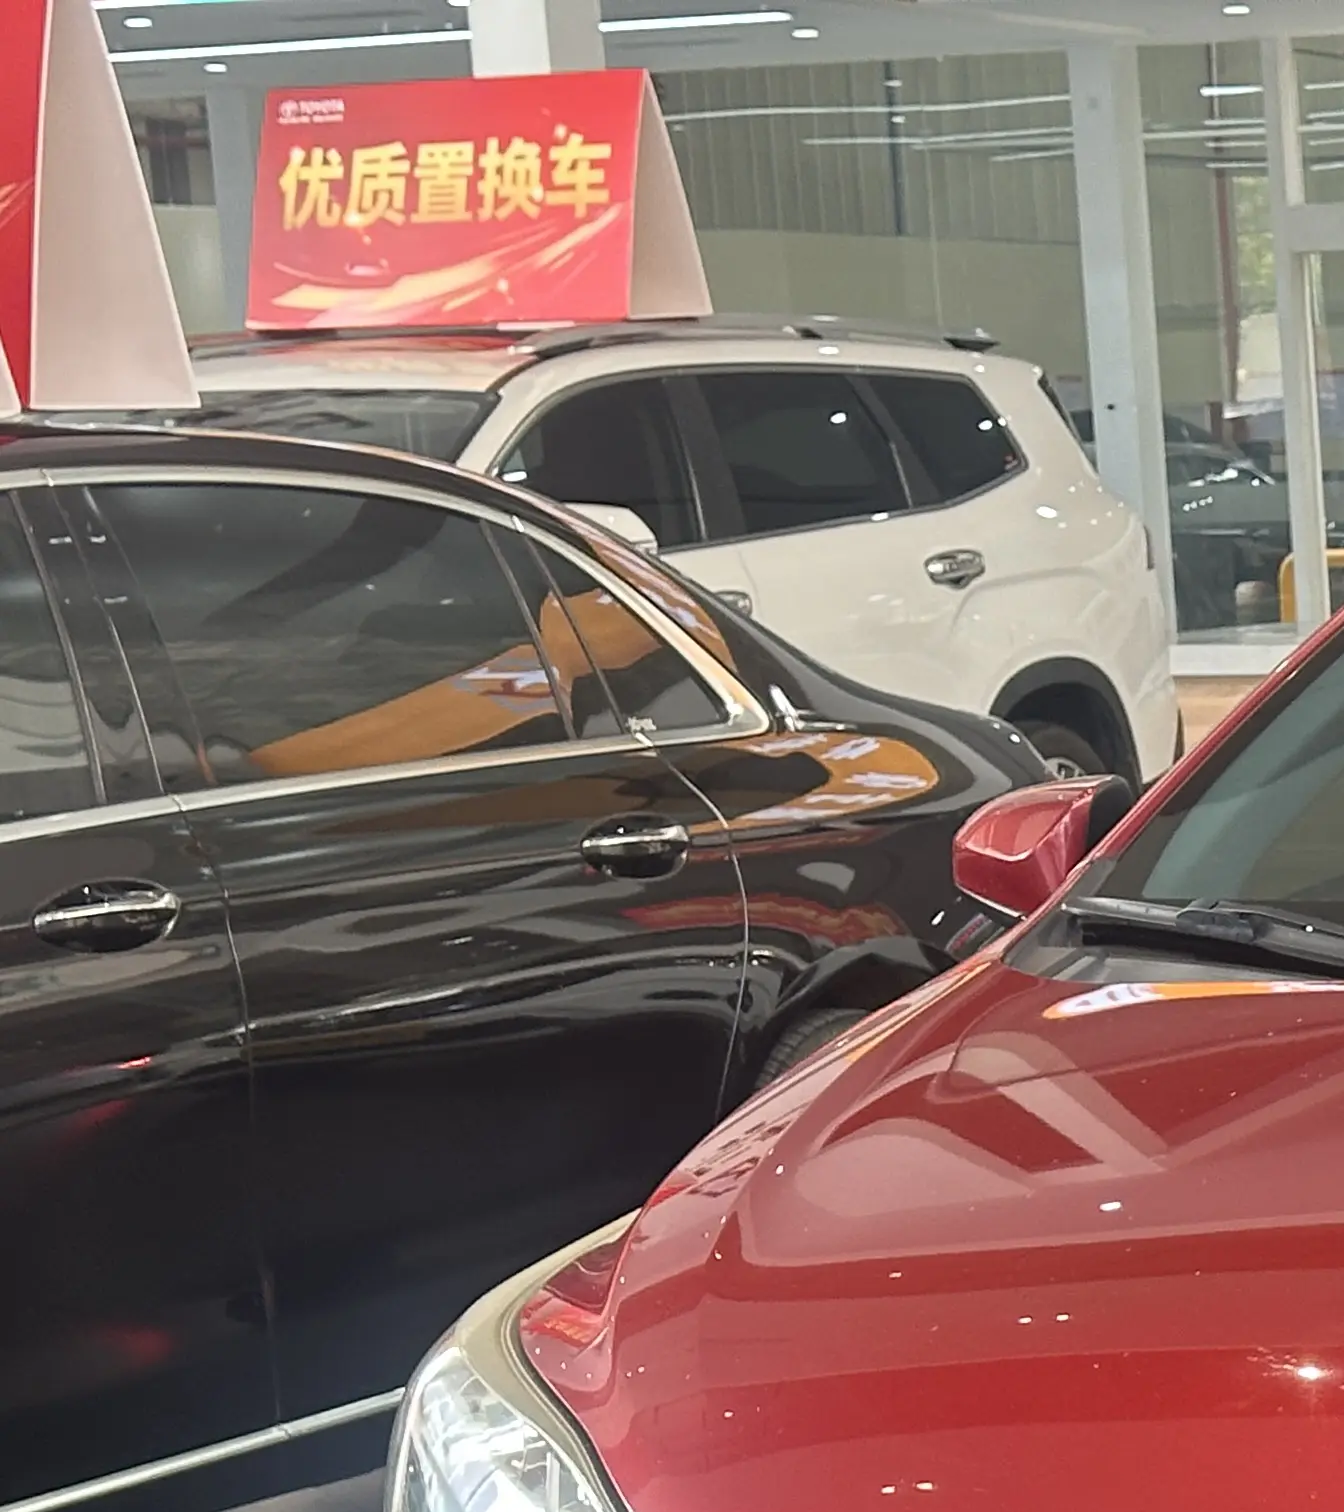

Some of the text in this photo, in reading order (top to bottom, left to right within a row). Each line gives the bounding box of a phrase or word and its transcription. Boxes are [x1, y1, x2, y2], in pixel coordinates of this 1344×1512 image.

[278, 132, 613, 230] 优质置换车
